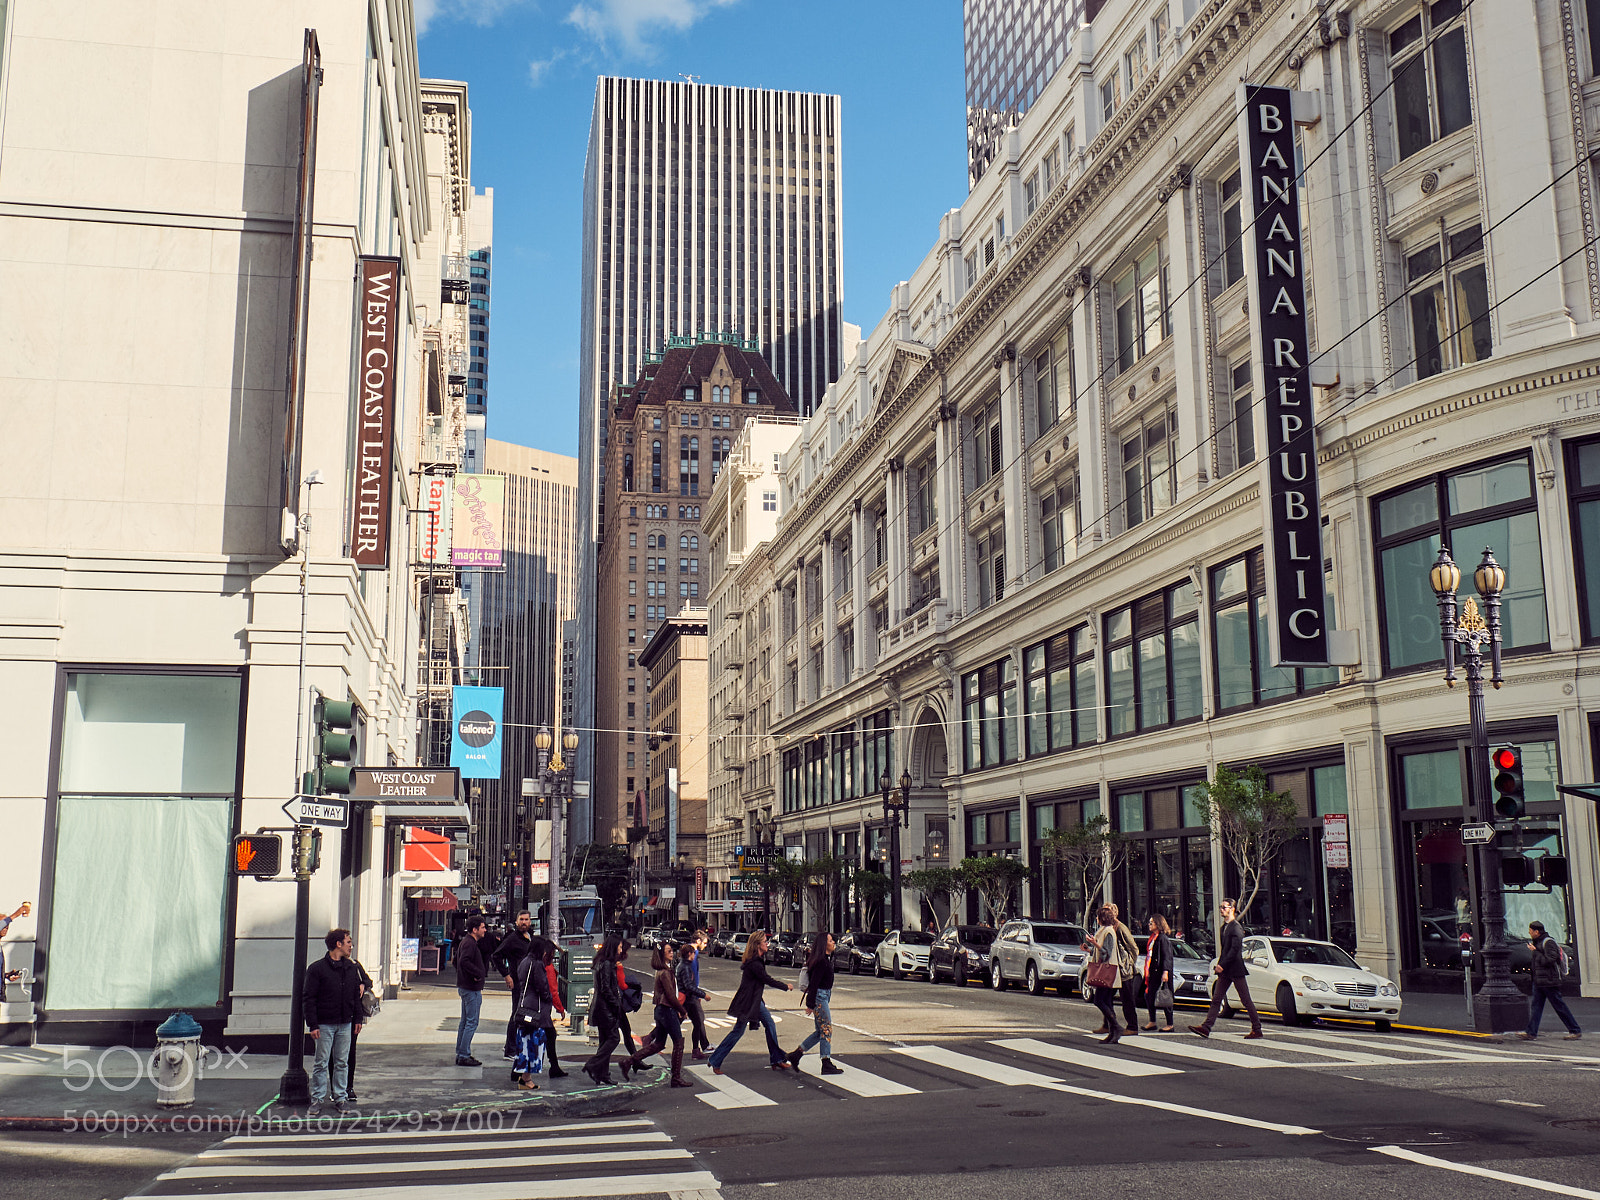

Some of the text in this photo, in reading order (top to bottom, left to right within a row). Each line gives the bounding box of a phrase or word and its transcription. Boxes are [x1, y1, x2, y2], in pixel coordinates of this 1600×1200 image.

[1259, 103, 1320, 639] BANANA REPUBLIC
[356, 271, 392, 556] WEST COAST LEATHER
[421, 479, 445, 560] tanning
[454, 550, 500, 562] magic tan
[459, 723, 494, 735] tailored
[371, 772, 437, 784] WEST COAST
[379, 784, 427, 796] LEATHER
[301, 804, 342, 819] ONE WAY
[1464, 829, 1485, 838] ONE WAY
[736, 846, 742, 854] P
